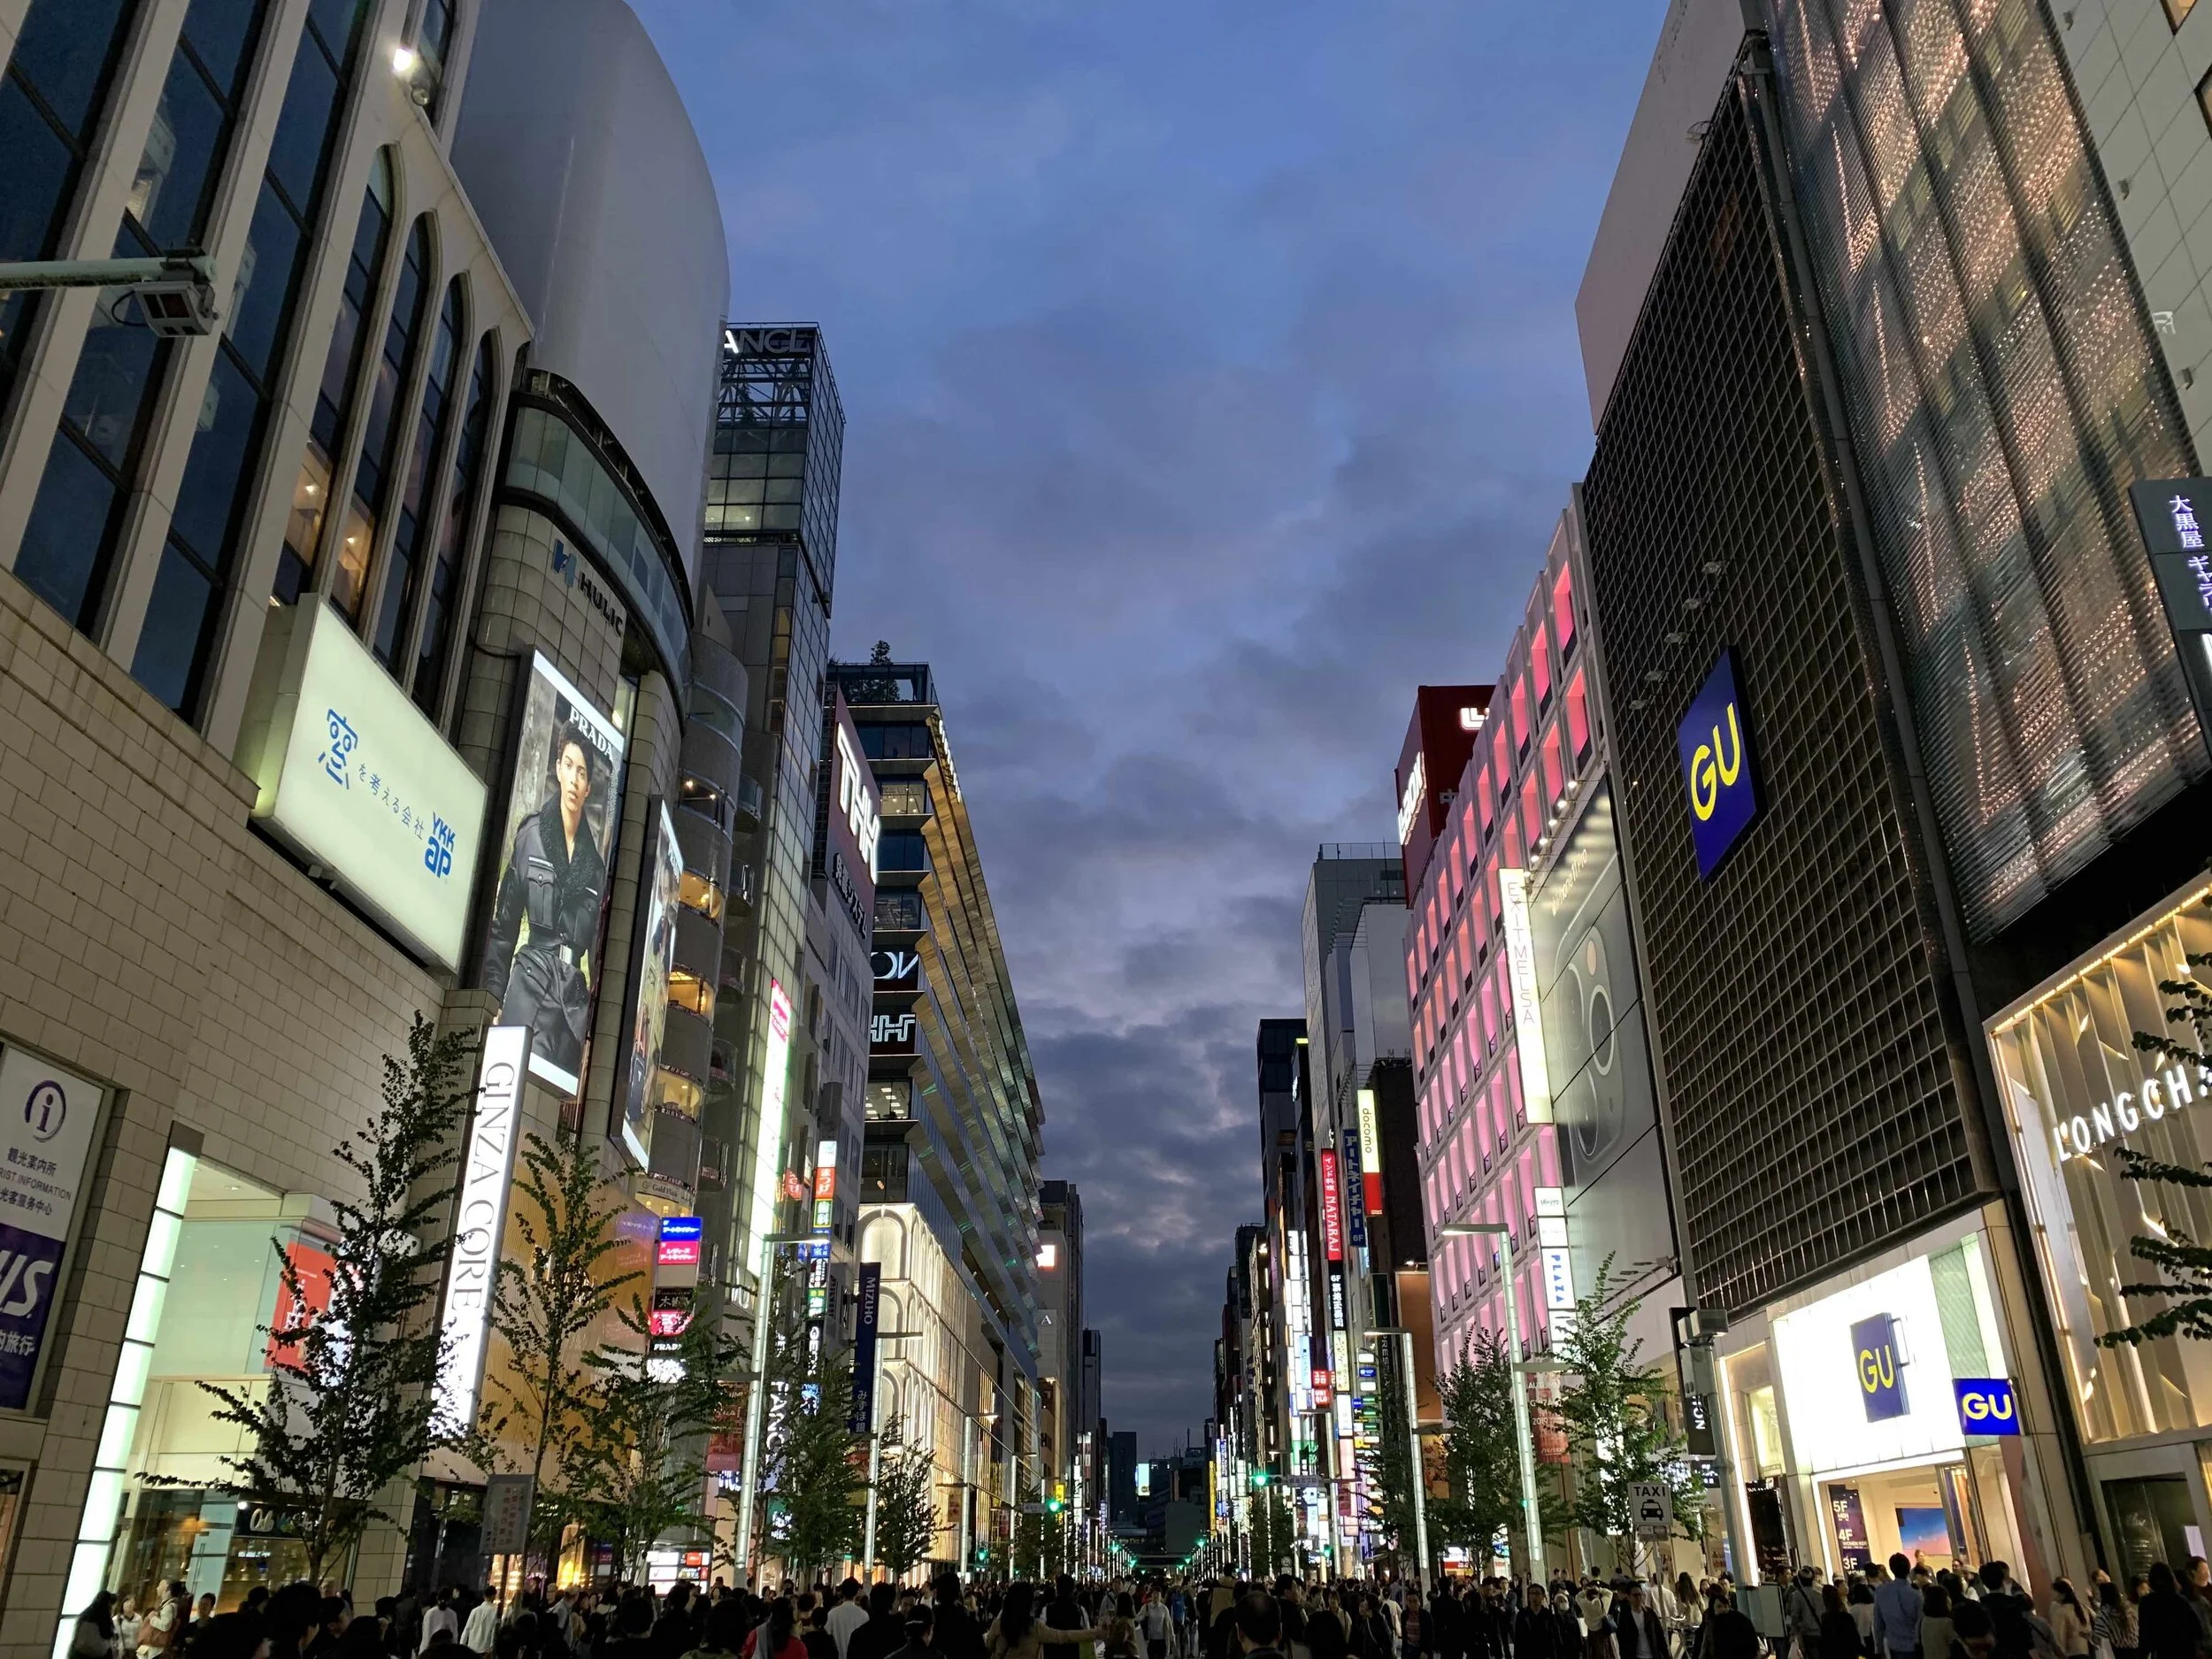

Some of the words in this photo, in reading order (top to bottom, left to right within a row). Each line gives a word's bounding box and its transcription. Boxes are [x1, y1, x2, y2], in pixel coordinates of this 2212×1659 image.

[2169, 495, 2205, 549] 大黒屋
[580, 572, 624, 637] HULIC
[570, 705, 614, 761] PRADA
[1691, 702, 1740, 821] GU
[837, 722, 881, 886] THK
[432, 811, 456, 853] YKK
[425, 836, 452, 879] ap
[1508, 881, 1535, 1025] EXITMELSA
[470, 1062, 515, 1186] GINZA
[1363, 1108, 1372, 1154] docomo
[8, 1147, 57, 1177] 観光案内所
[1345, 1135, 1362, 1228] アートネイチャー
[18, 1174, 72, 1201] INFORMATION
[1325, 1195, 1340, 1253] NATARAJ
[451, 1199, 495, 1310] CORE
[1551, 1254, 1565, 1303] PLAZA
[864, 1277, 875, 1325] MIZUHO
[1859, 1344, 1894, 1393] GU
[765, 1381, 789, 1465] FANC
[1962, 1392, 2013, 1420] GU
[1633, 1486, 1665, 1496] TAXI
[1832, 1500, 1847, 1512] 5F
[1839, 1529, 1853, 1540] 4F
[1843, 1557, 1858, 1570] 3F
